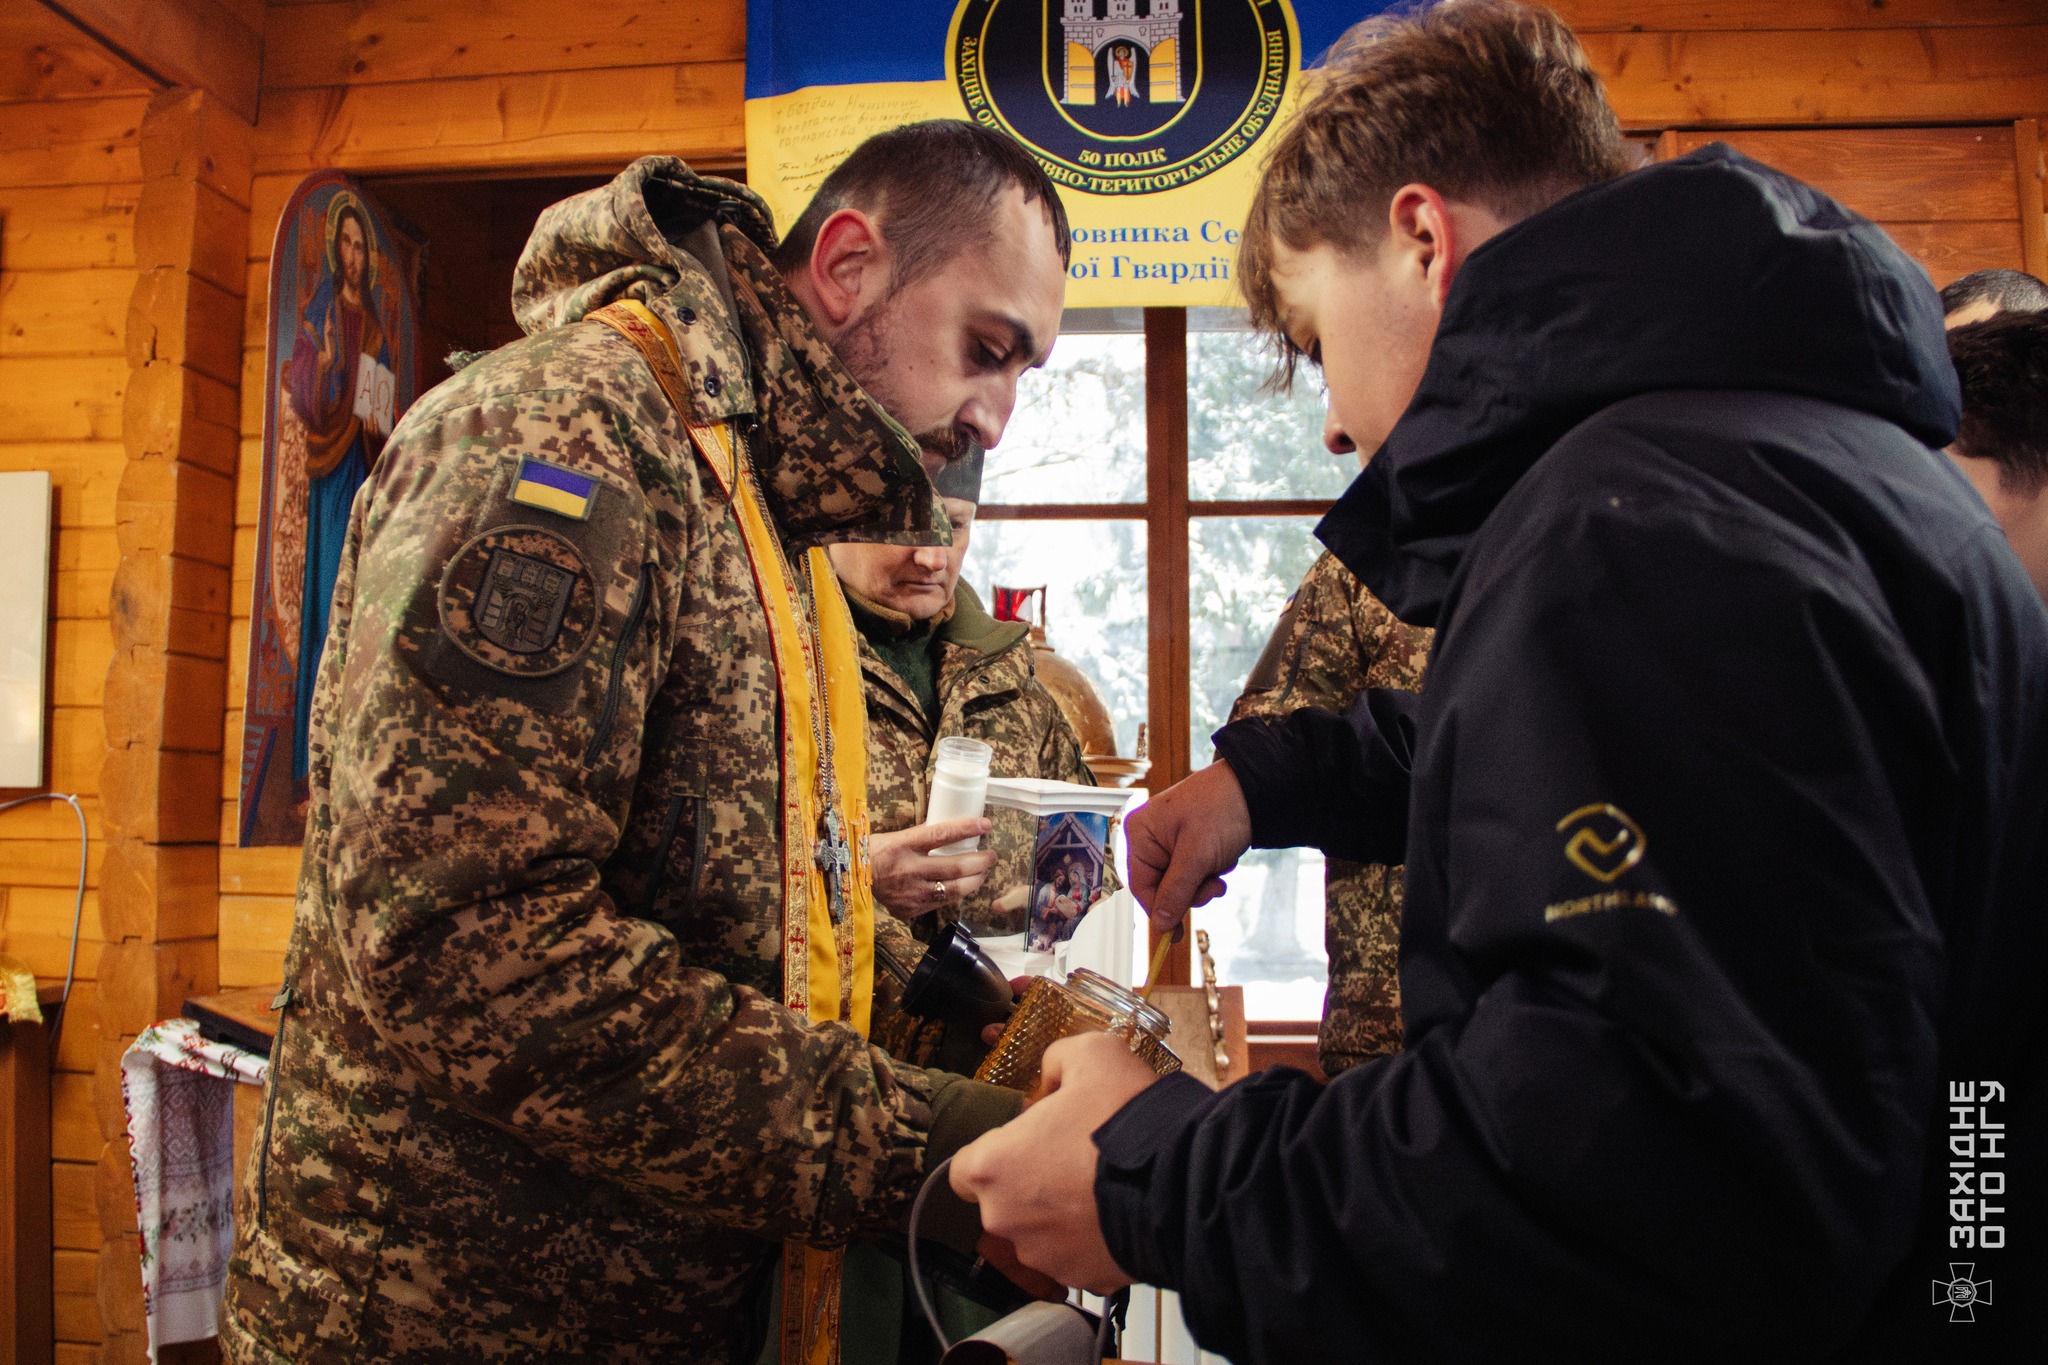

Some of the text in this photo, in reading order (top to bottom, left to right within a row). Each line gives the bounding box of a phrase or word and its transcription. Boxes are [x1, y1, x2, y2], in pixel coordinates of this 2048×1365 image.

[960, 36, 986, 110] ЗАХІДНЕ
[1078, 148, 1168, 168] 50 ПОЛК
[1071, 219, 1240, 245] овника Се
[1070, 255, 1230, 285] ої Гвардії
